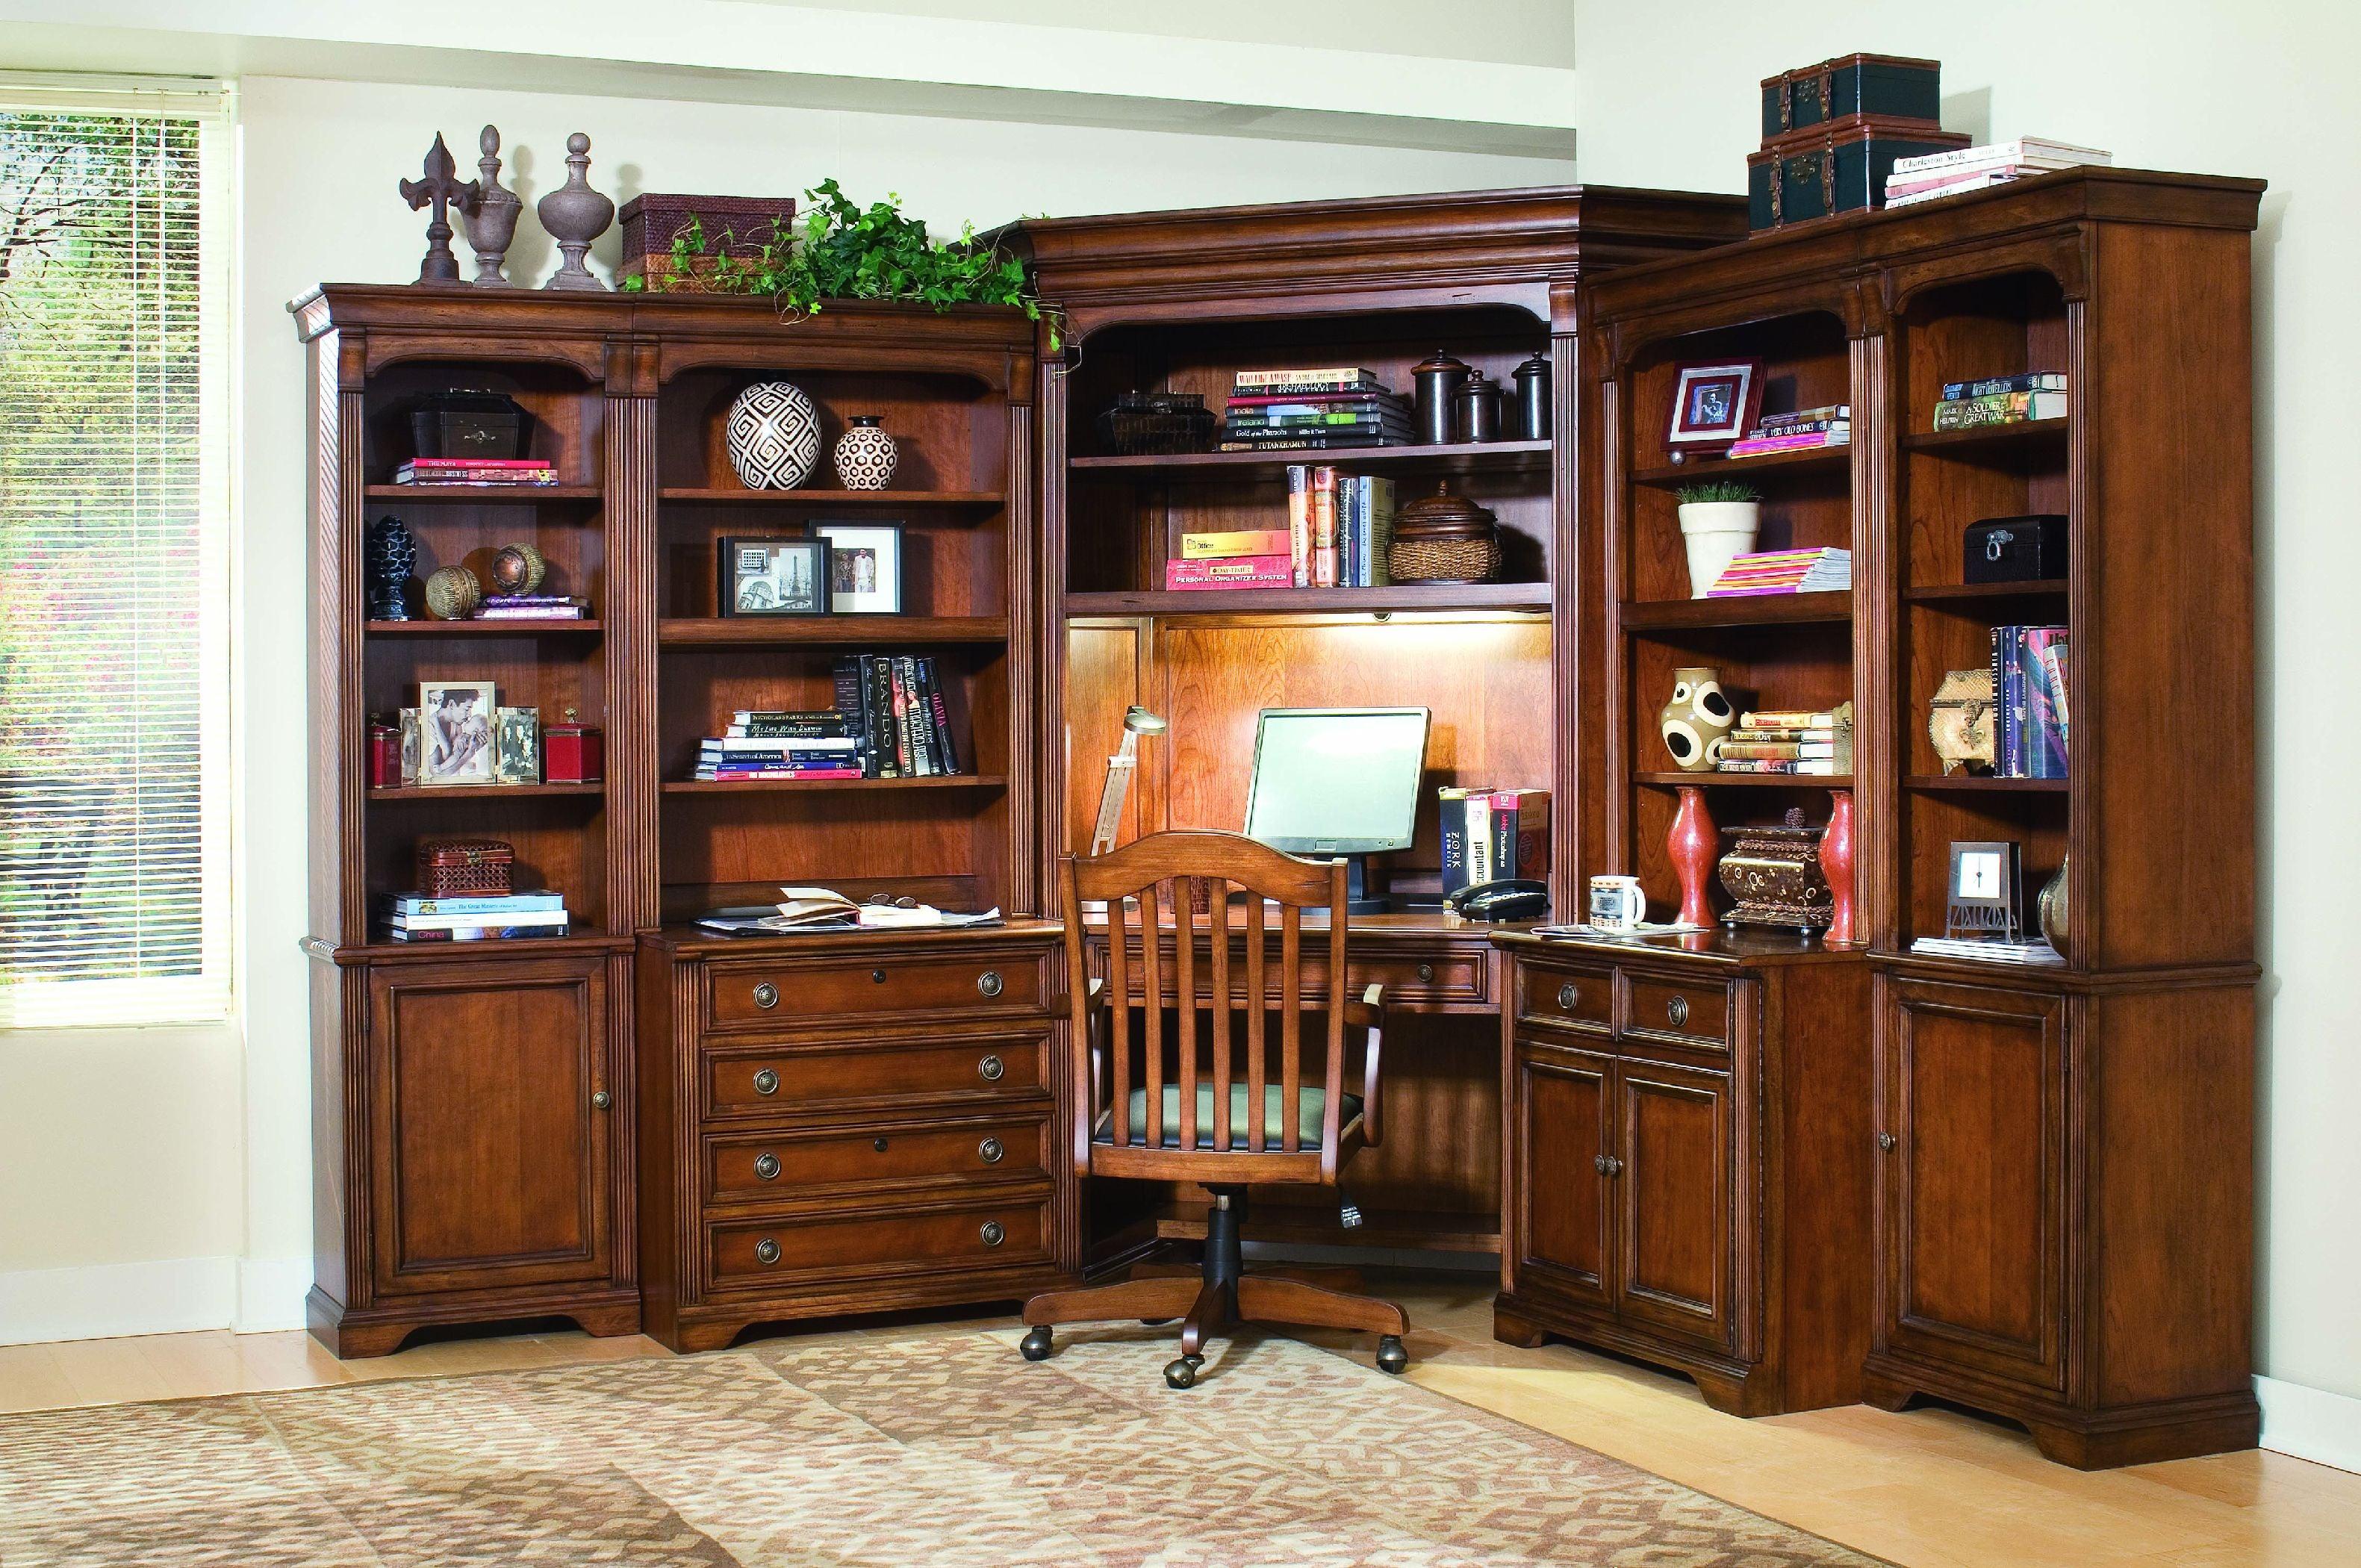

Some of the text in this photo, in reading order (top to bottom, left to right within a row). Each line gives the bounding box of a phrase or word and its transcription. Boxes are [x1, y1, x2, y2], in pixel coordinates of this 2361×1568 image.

[1903, 155, 1943, 168] Charleston
[1946, 152, 1966, 164] Style
[1278, 382, 1329, 391] ARCHAEOLOGY
[1965, 406, 1973, 414] A
[1973, 402, 2000, 413] SOLDIER
[1939, 417, 1959, 425] HELPRIN
[1964, 411, 2004, 425] GREAT WAR
[1770, 423, 1814, 437] VERY OLD BONES
[1258, 441, 1307, 449] TUTANKHAMUN
[878, 663, 892, 748] BRANDO
[933, 693, 947, 727] OLIVIA
[1500, 814, 1508, 831] Adobe
[1451, 832, 1461, 868] ZORK
[1498, 830, 1508, 861] Photoshop
[1473, 841, 1484, 884] ccountant
[417, 930, 445, 939] China
